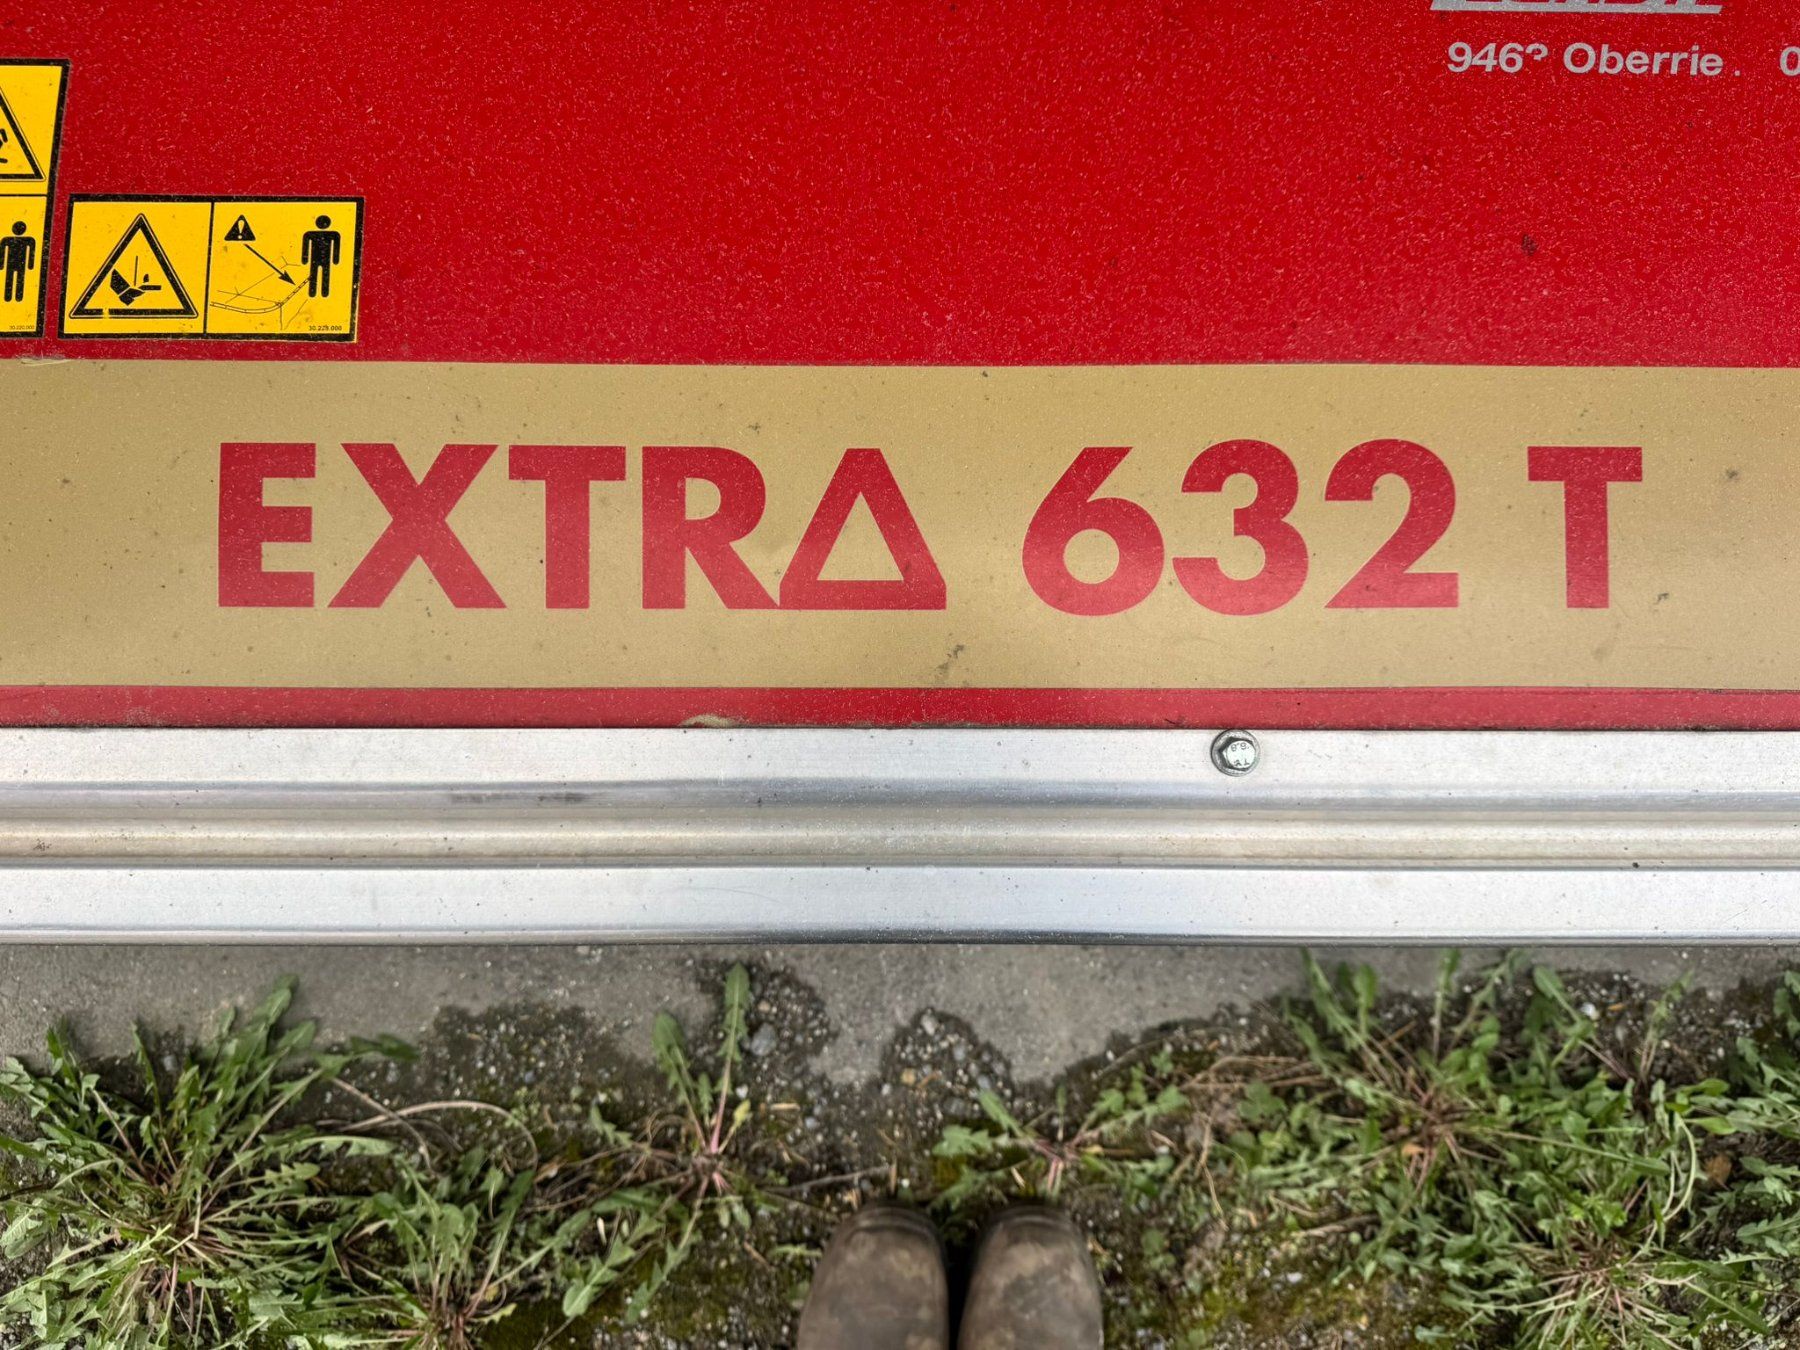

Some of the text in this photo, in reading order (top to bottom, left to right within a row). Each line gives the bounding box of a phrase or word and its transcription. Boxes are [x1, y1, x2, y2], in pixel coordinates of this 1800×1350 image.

[218, 438, 1643, 616] EXTRA 632 T
